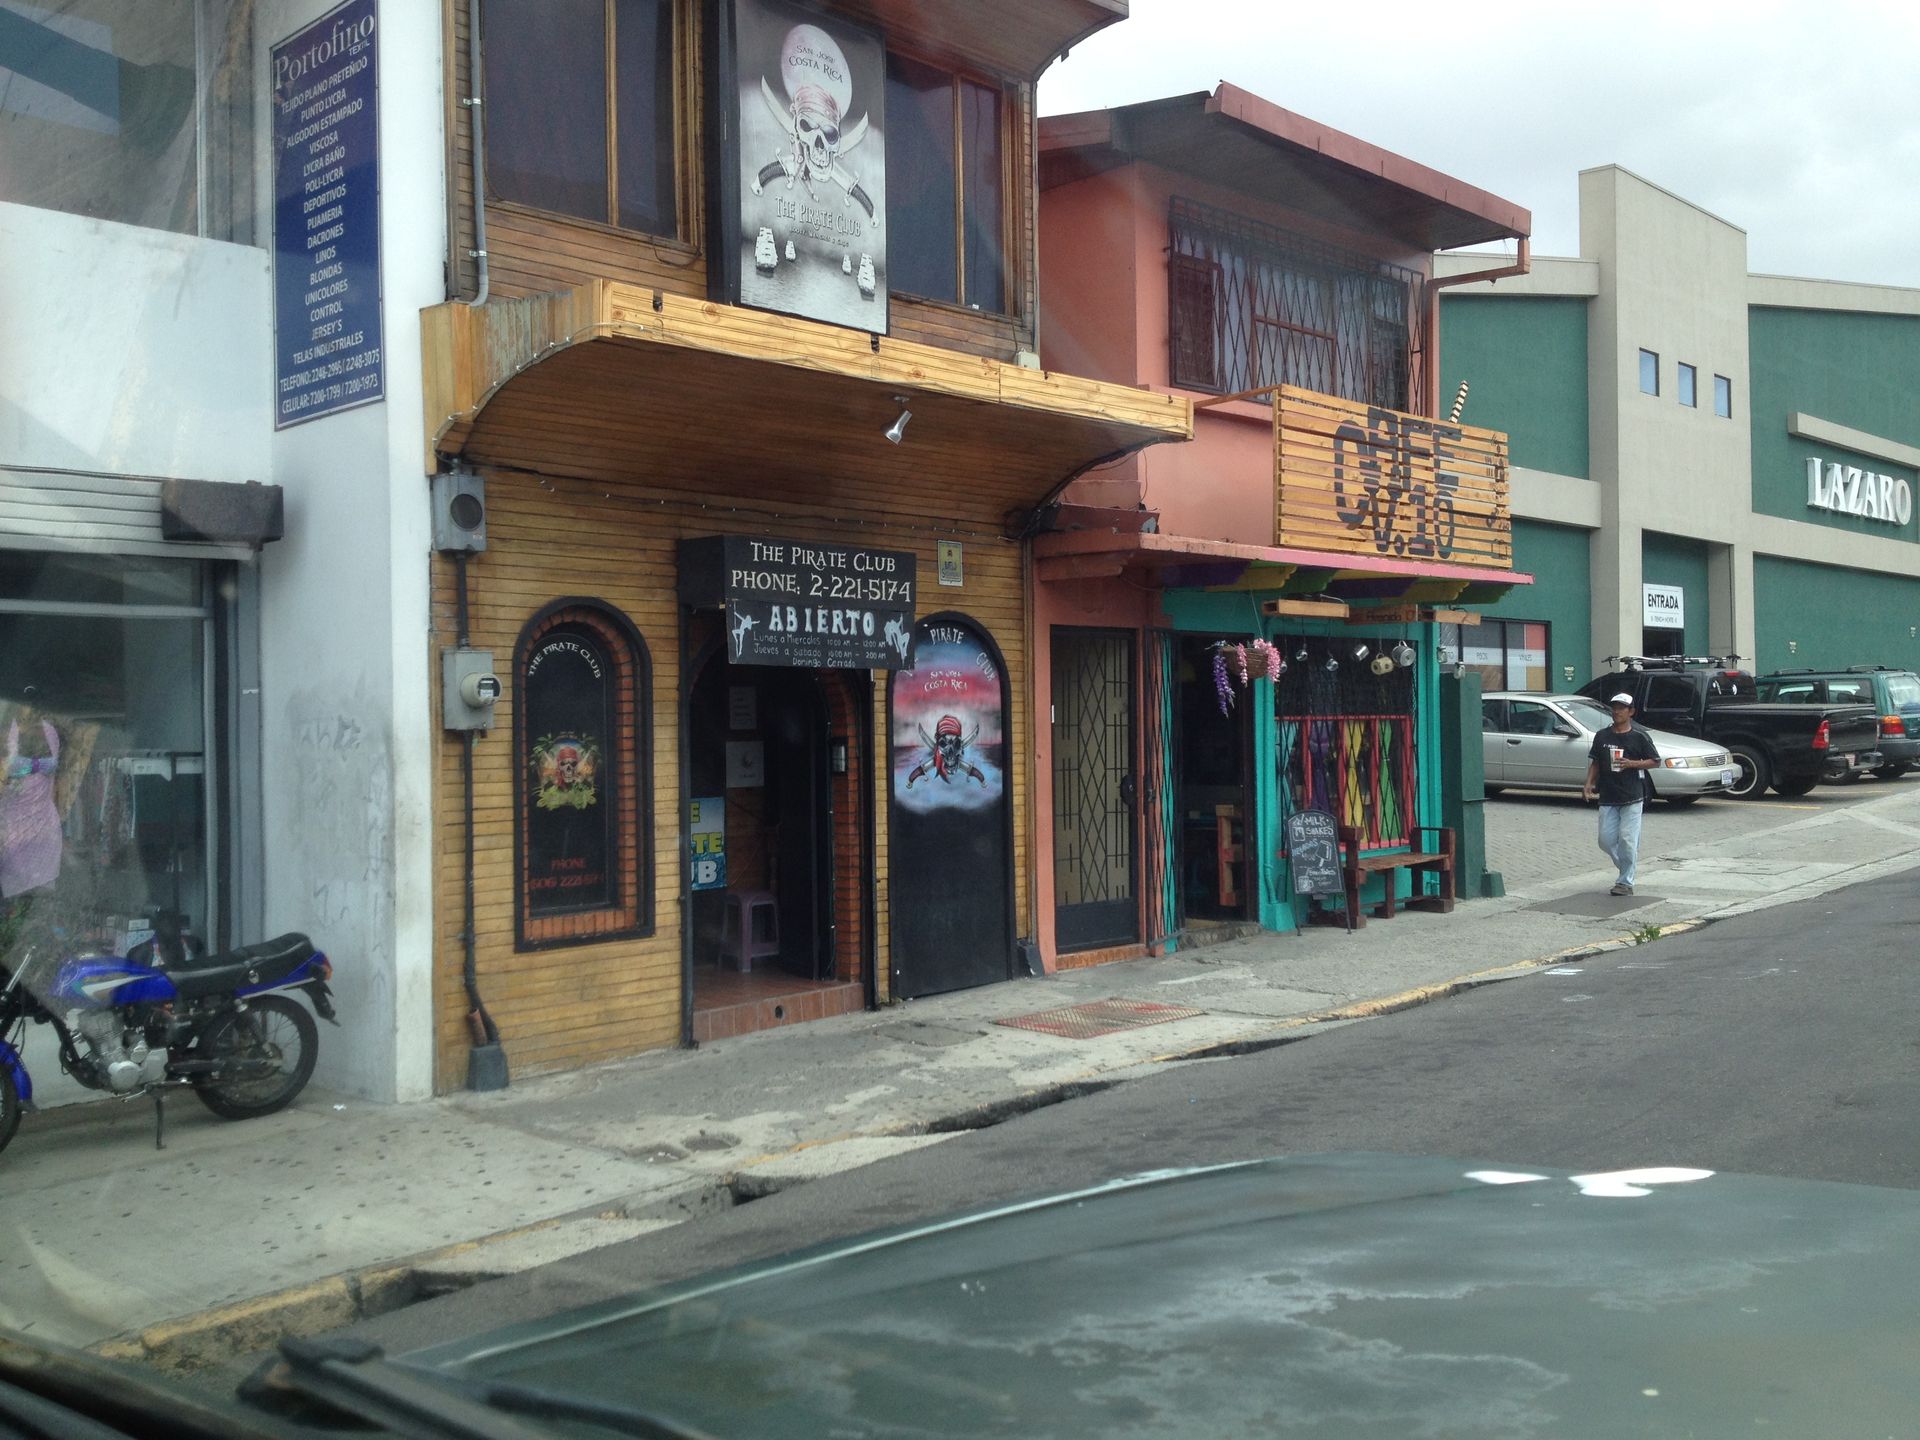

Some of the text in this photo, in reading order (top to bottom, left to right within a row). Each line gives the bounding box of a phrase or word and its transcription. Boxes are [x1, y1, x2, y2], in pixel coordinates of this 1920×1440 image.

[275, 15, 374, 90] Portofino
[349, 40, 370, 56] TEXTIL
[797, 45, 813, 54] SAN
[789, 56, 843, 83] COSTA RICA
[282, 56, 368, 114] TEJIDO PLANO PRETEÑIDO
[301, 88, 346, 122] PUNTO LYCRA
[287, 98, 363, 148] ALGODON ESTAMPADO
[309, 130, 338, 154] VISCOSA
[303, 146, 345, 177] LYCRA BAÑO
[305, 166, 344, 194] POLI-LYCRA
[303, 184, 346, 213] DEPORTIVOS
[775, 196, 861, 237] THE PIRATE CLUB
[307, 223, 344, 249] DACRONES
[315, 245, 336, 264] LINOS
[310, 262, 342, 285] BLONDAS
[305, 279, 348, 306] UNICOLORES
[310, 301, 343, 322] CONTROL
[312, 319, 342, 340] JERSEY'S
[293, 331, 364, 365] TELAS INDUSTRIALES
[346, 348, 380, 372] 2248-3075
[1806, 457, 1912, 525] LAZARO
[750, 541, 896, 572] THE PIRATE CLUB
[731, 569, 911, 603] PHONE: 2-221-5174
[1648, 593, 1679, 610] ENTRADA
[768, 605, 875, 636] ABIERTO
[753, 631, 778, 644] Lunes
[786, 633, 821, 645] Miercoles
[753, 642, 779, 655] Jueves
[929, 627, 964, 646] PIRATE
[528, 641, 601, 678] THE PIRATE CLUB
[792, 657, 822, 668] Domingo
[924, 679, 968, 692] COSTA RICA
